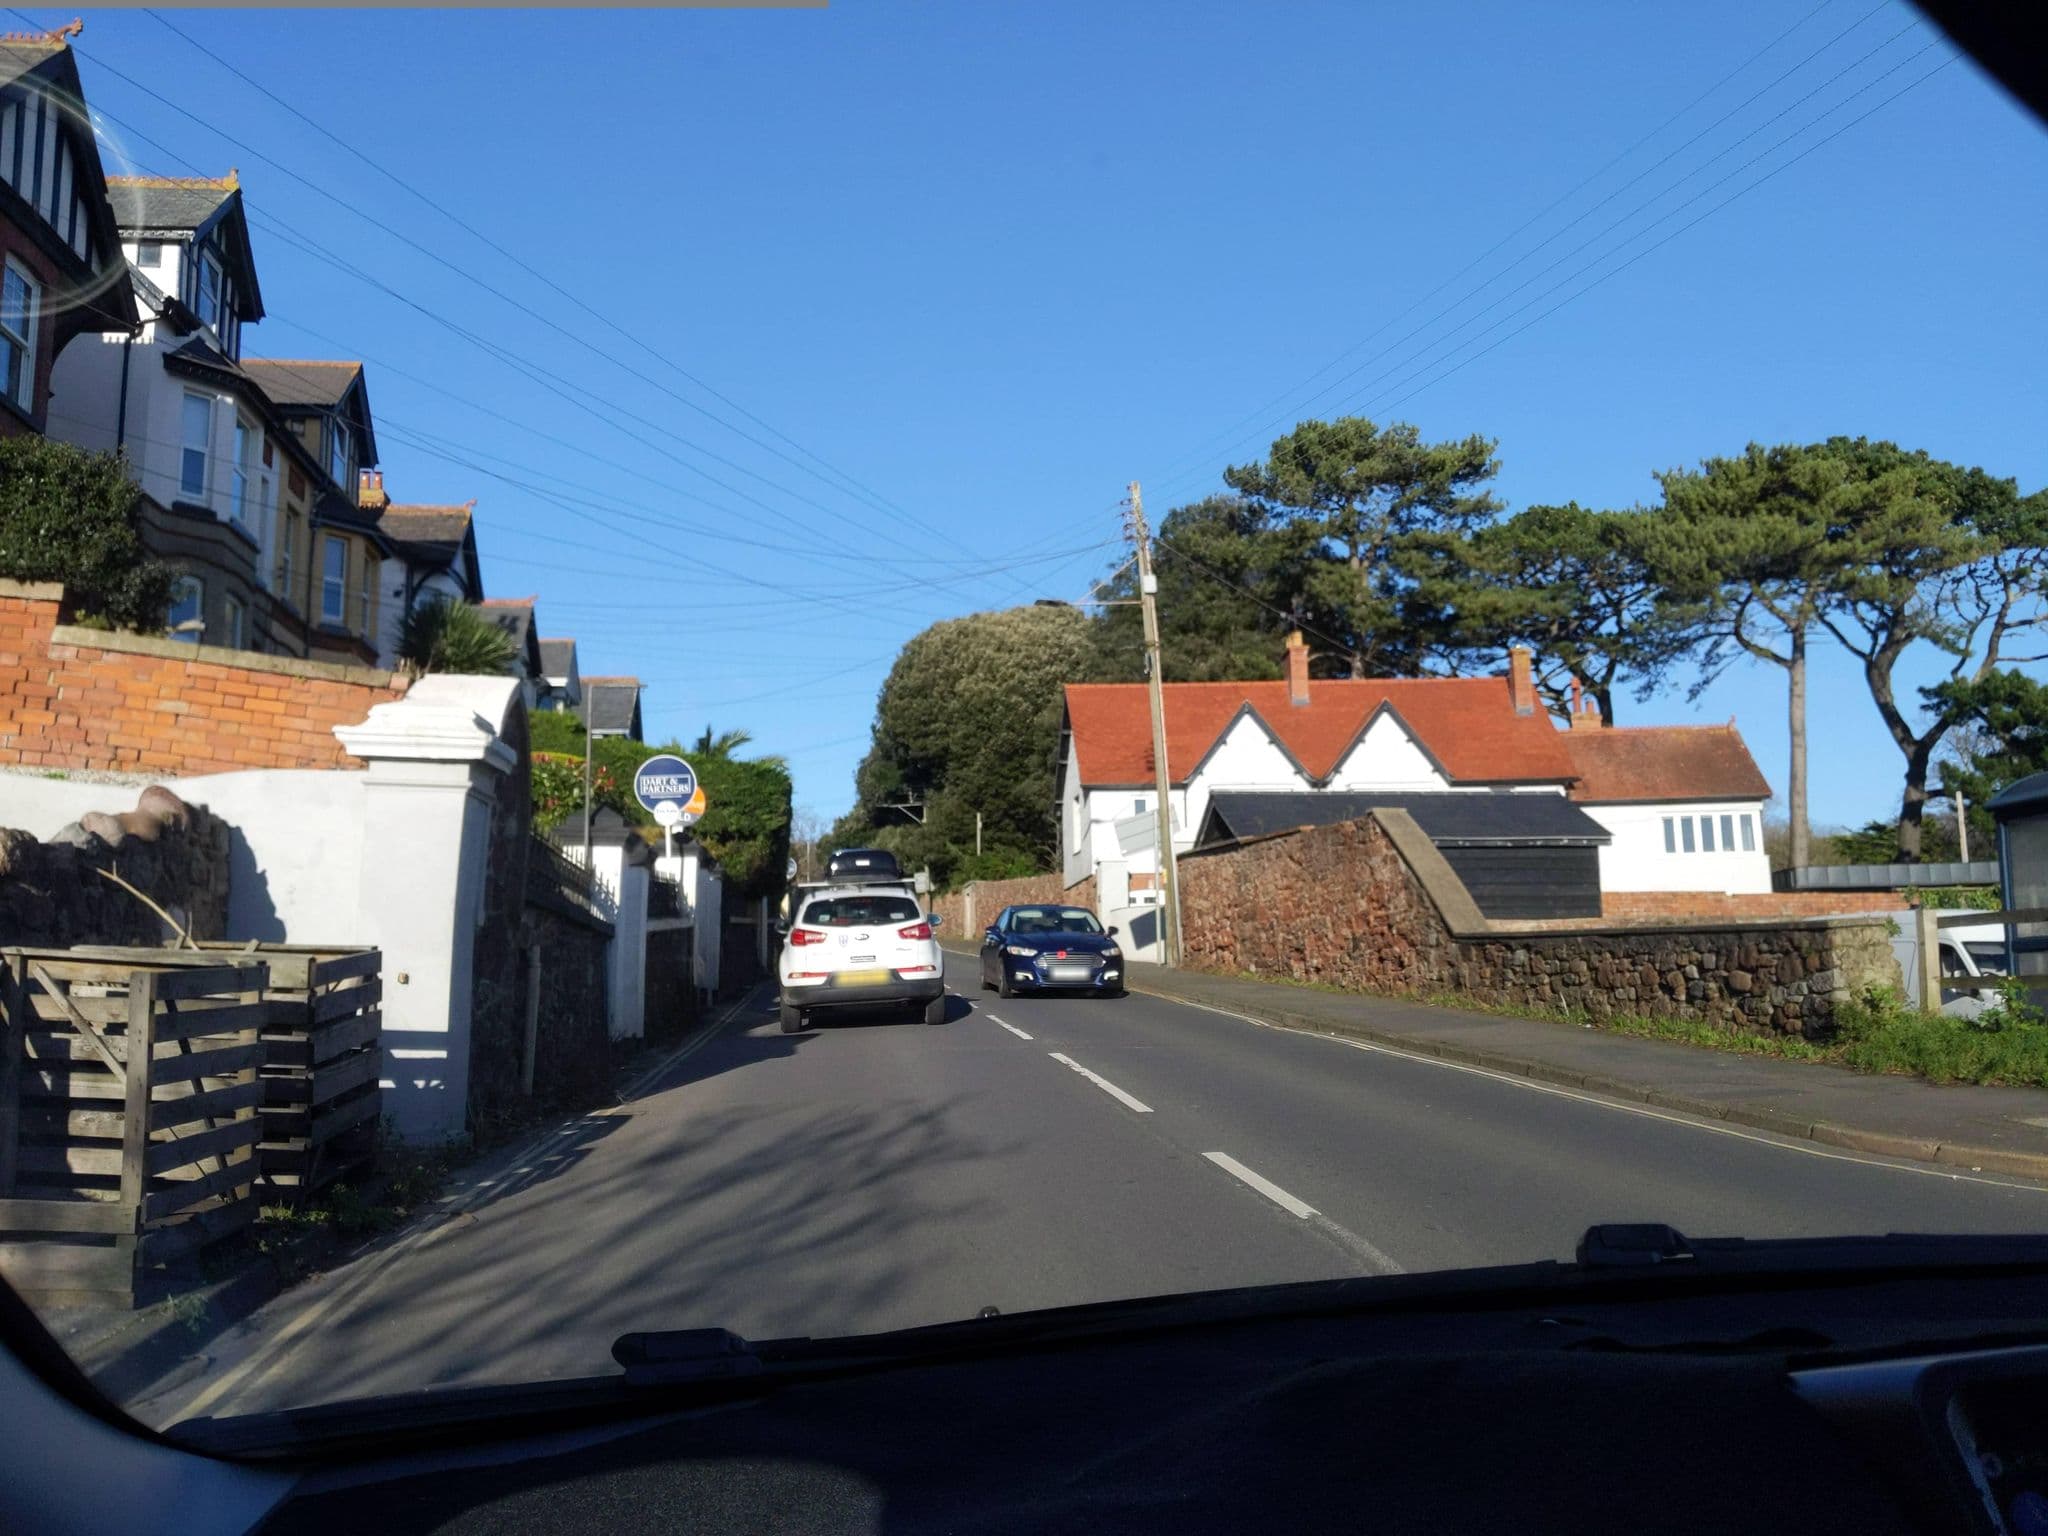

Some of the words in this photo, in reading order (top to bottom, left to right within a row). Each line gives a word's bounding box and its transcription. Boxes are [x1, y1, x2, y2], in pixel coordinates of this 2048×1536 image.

[642, 777, 667, 786] DART
[669, 777, 678, 786] &
[642, 783, 689, 793] PARTNERS
